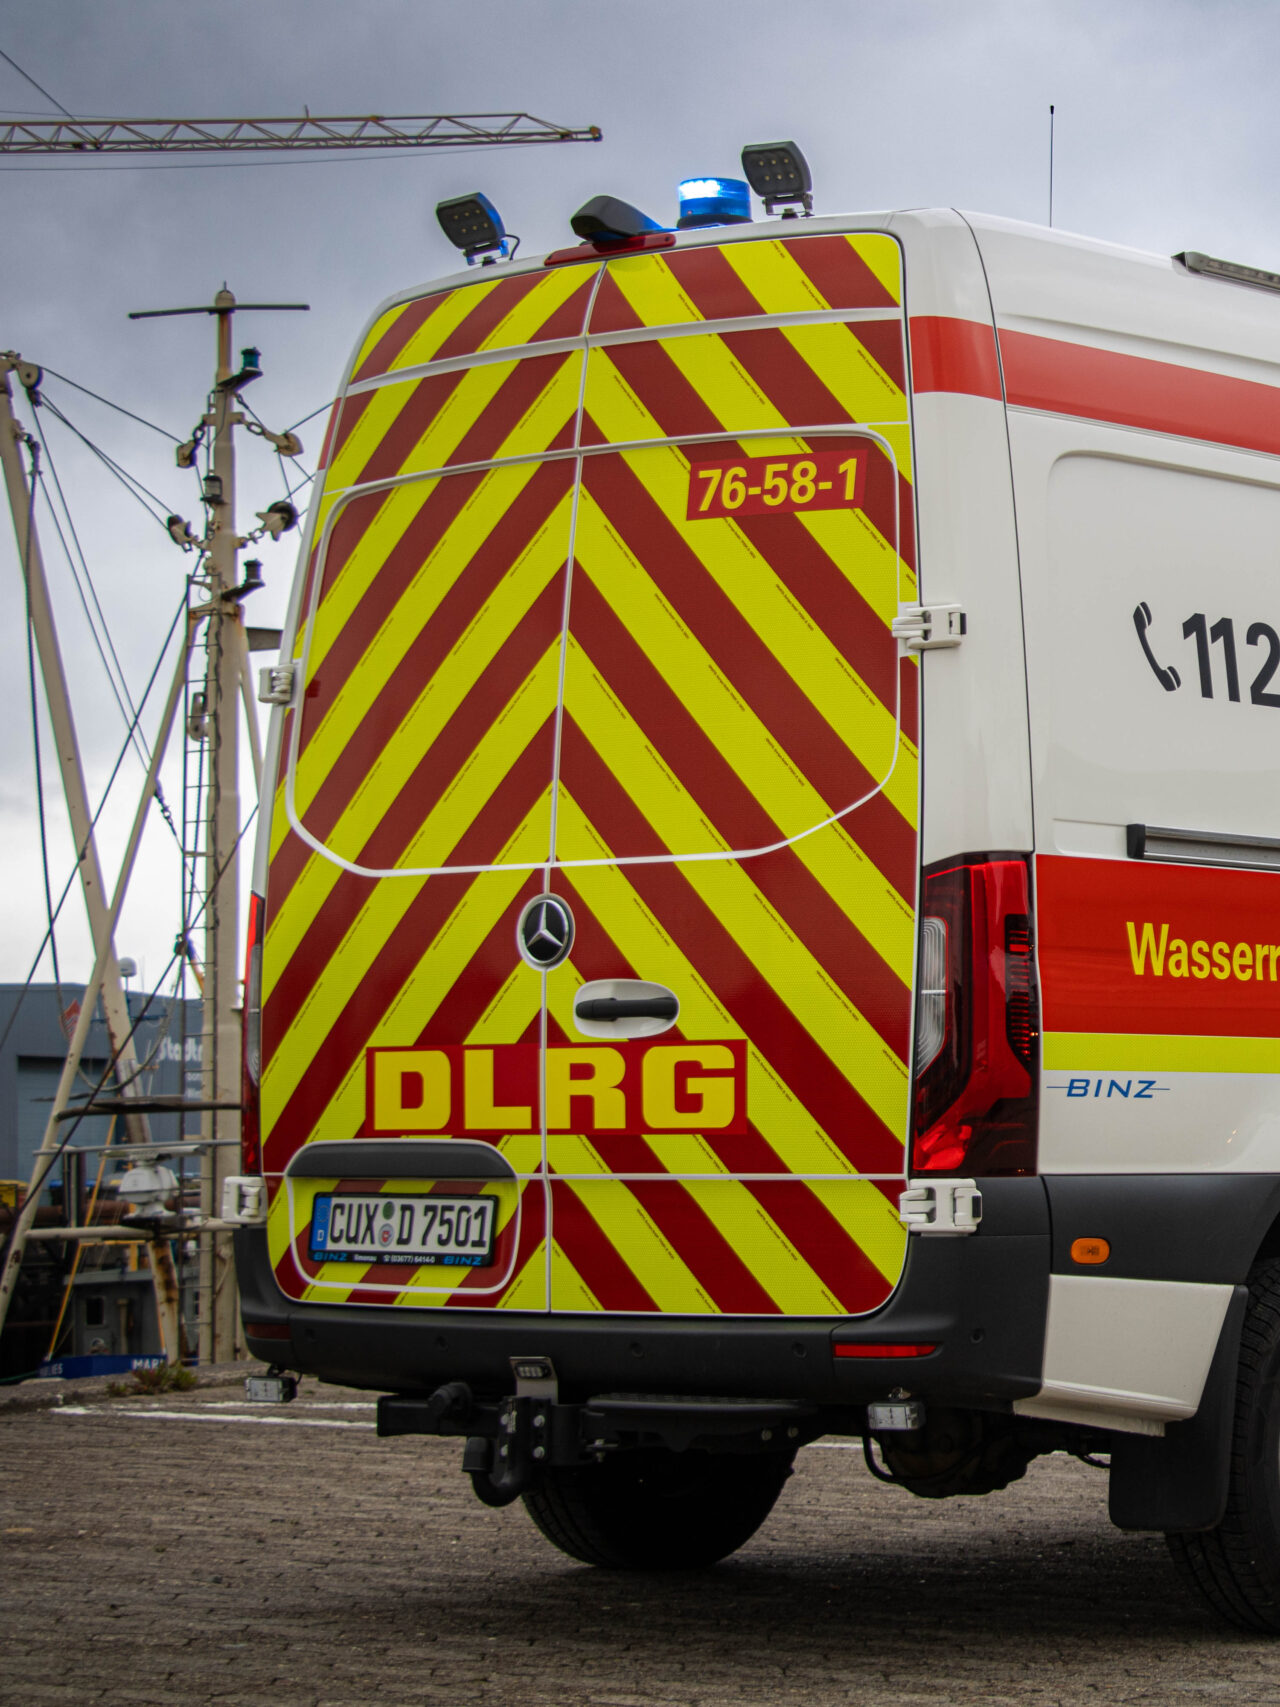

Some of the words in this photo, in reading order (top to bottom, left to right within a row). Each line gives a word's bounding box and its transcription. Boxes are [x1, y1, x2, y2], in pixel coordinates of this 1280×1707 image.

[697, 457, 858, 512] 76-58-1
[374, 1045, 735, 1130] DLRG
[1065, 1078, 1158, 1099] BINZ
[330, 1203, 379, 1245] CUX
[396, 1204, 415, 1245] D
[421, 1204, 487, 1248] 7501
[443, 1255, 483, 1266] BINZ
